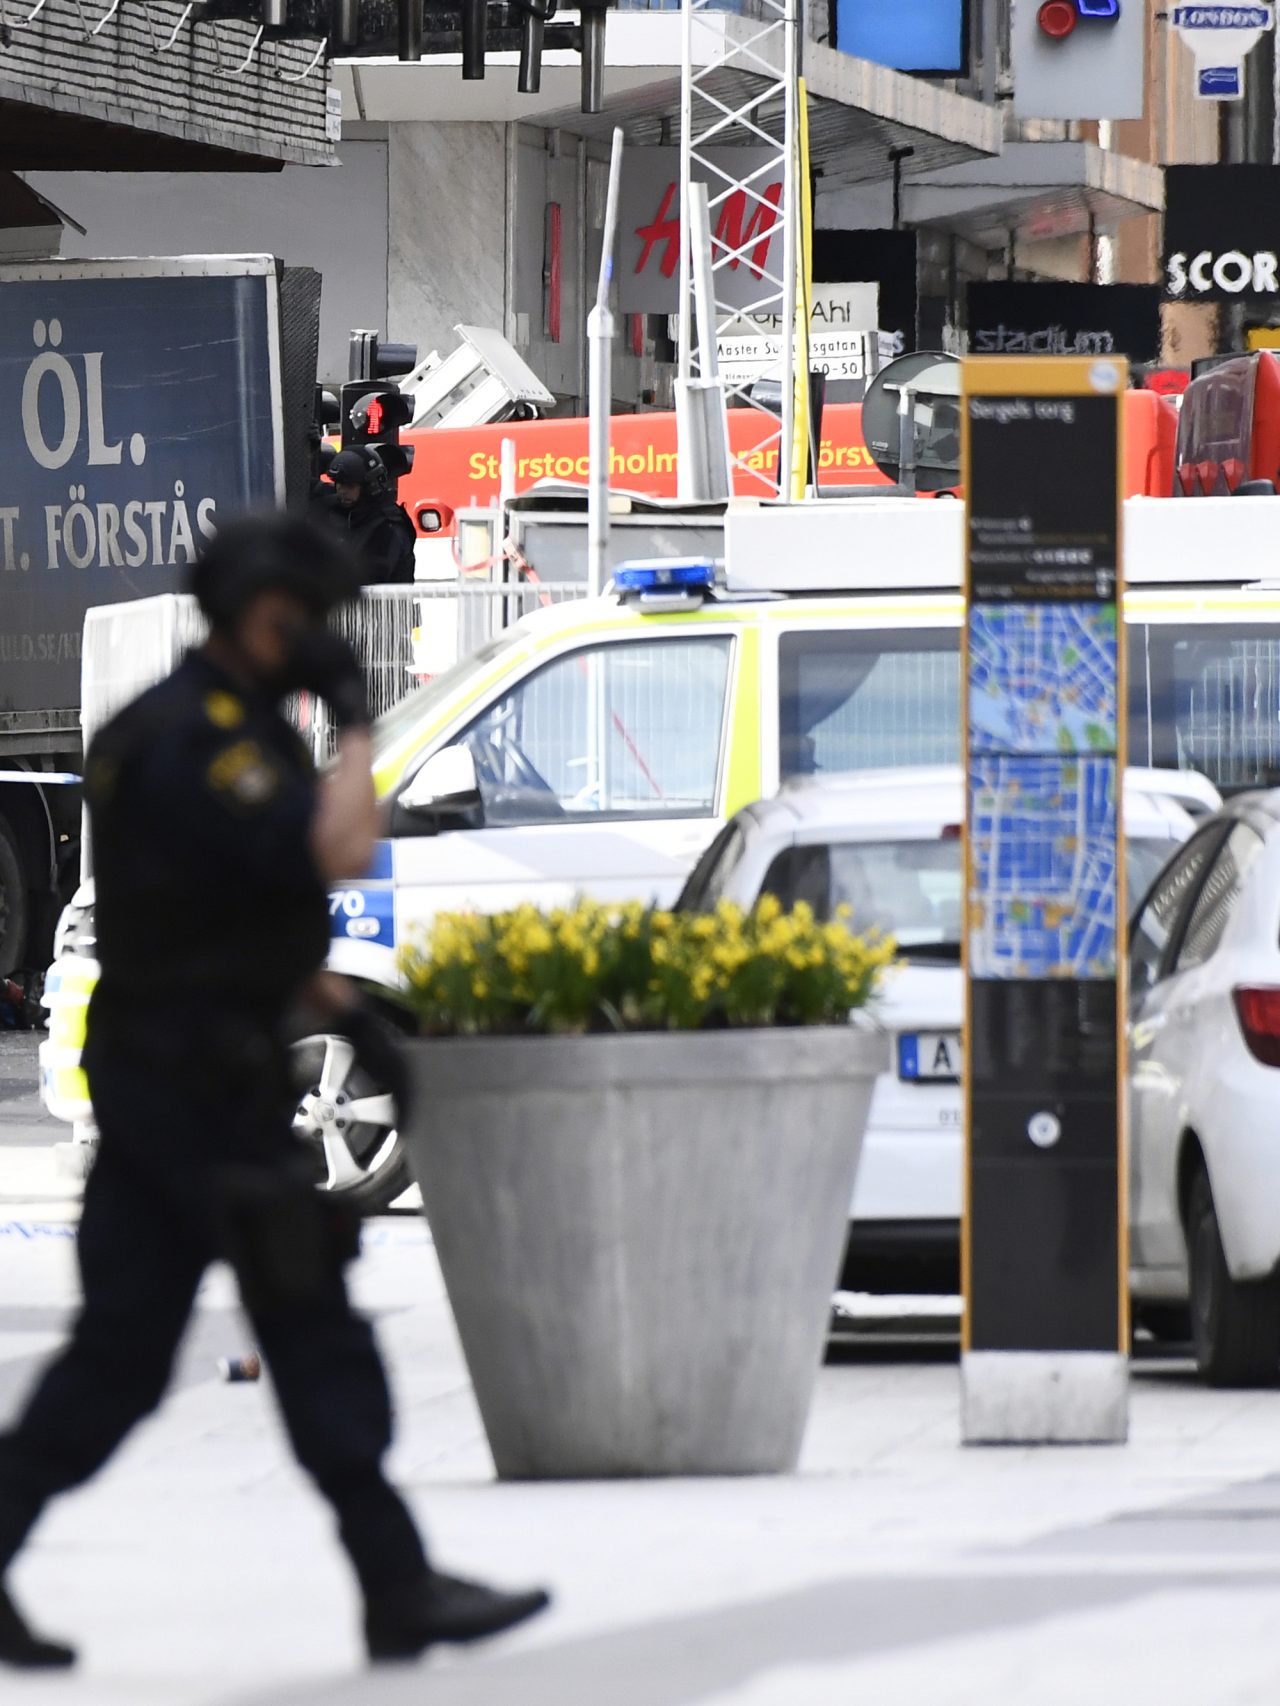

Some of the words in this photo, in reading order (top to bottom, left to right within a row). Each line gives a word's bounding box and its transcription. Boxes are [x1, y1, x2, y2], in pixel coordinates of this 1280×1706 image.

[635, 182, 782, 281] HM
[1168, 250, 1280, 295] SCOR
[21, 318, 147, 470] ÖL.
